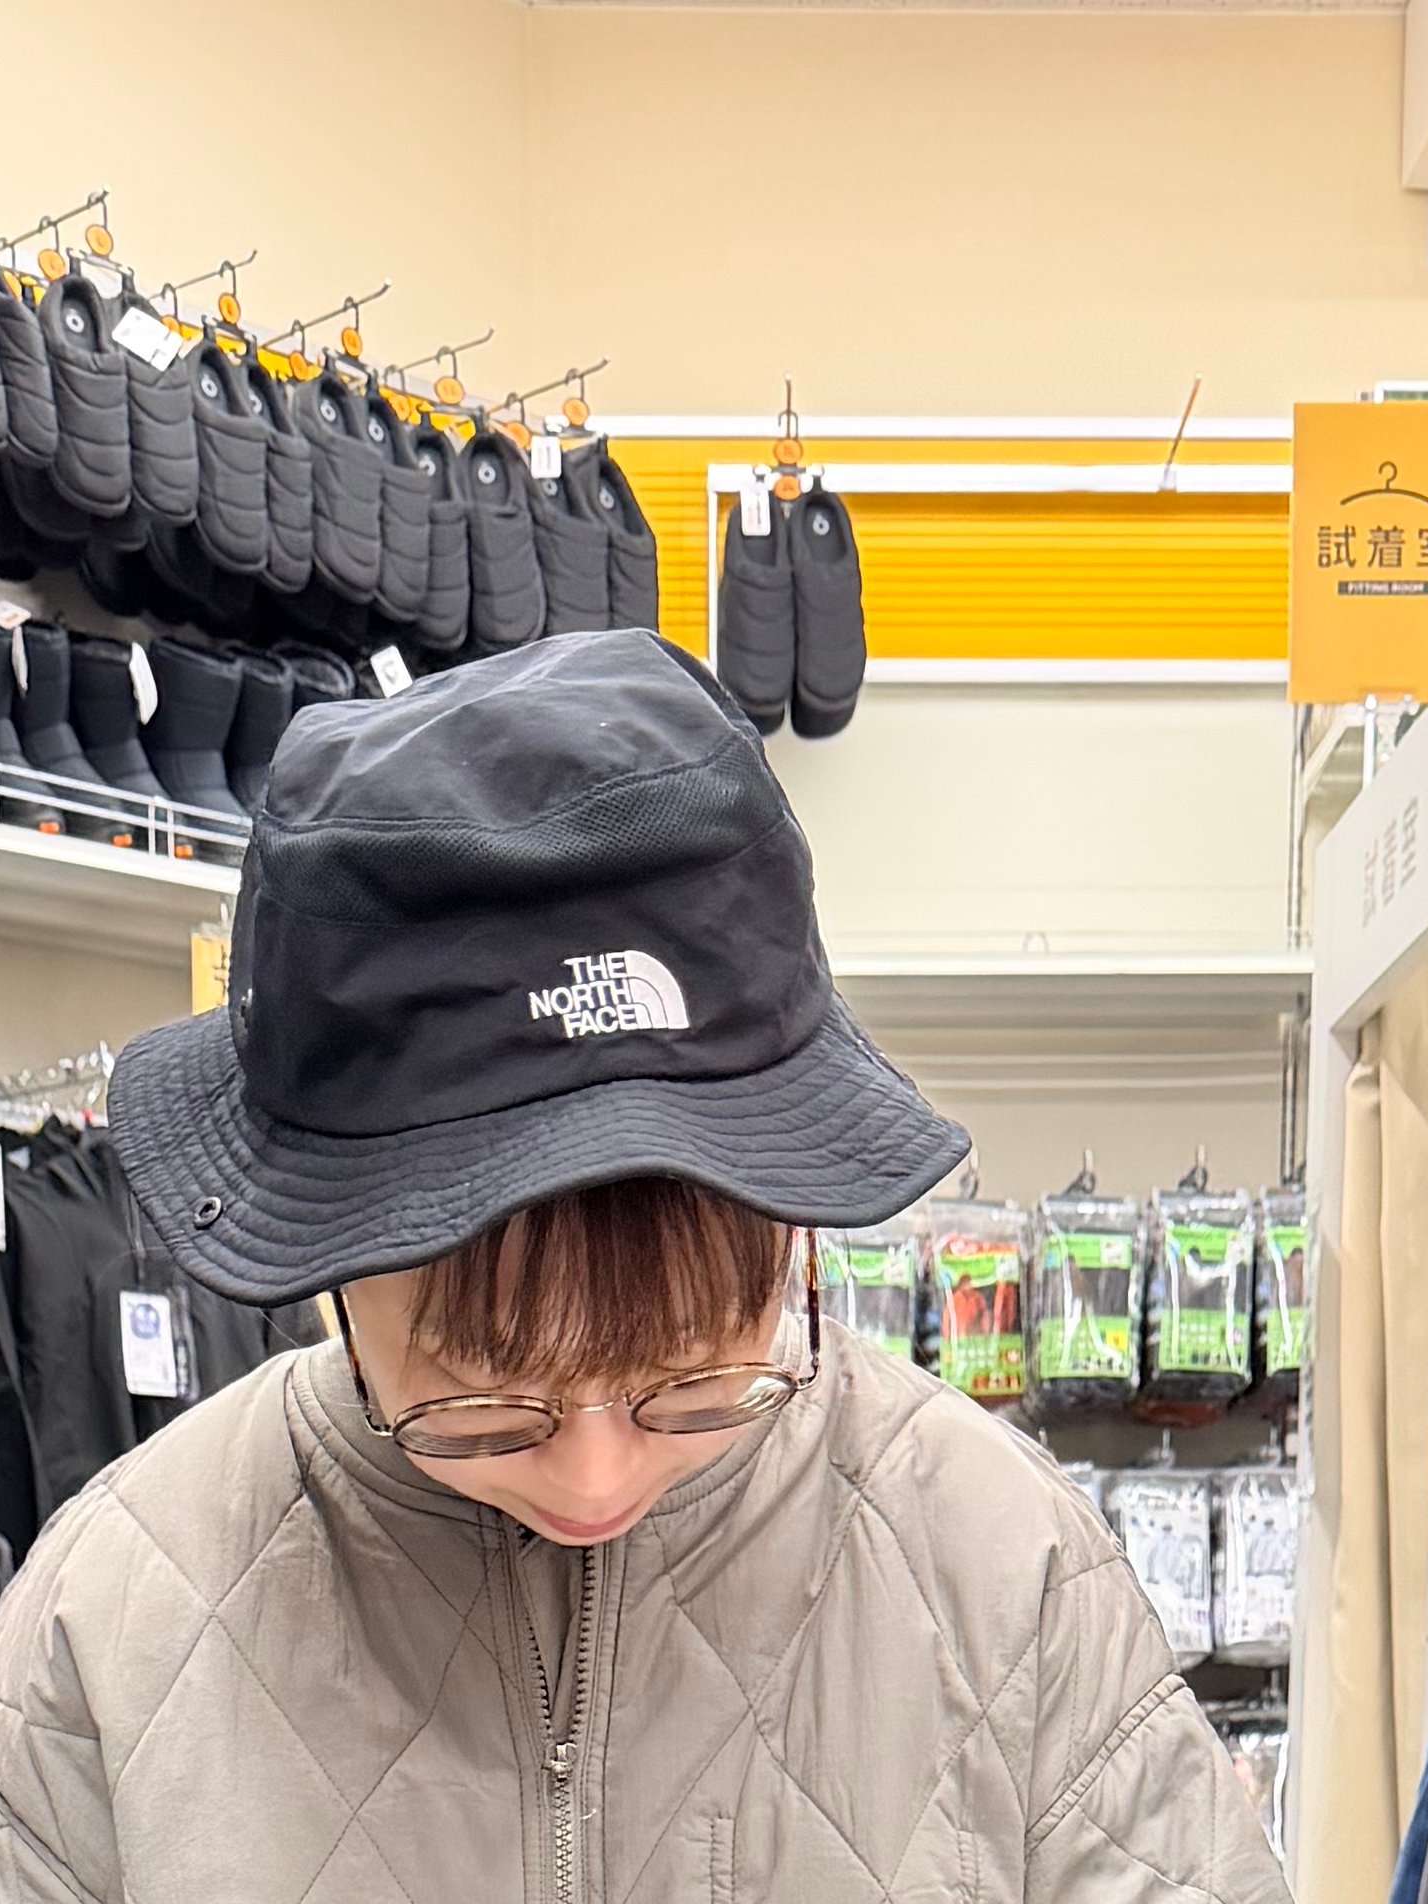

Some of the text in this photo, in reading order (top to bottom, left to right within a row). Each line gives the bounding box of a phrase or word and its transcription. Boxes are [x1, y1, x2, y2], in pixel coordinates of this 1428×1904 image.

[564, 952, 626, 984] THE
[529, 978, 631, 1019] NORTH
[563, 1004, 637, 1039] FACE
